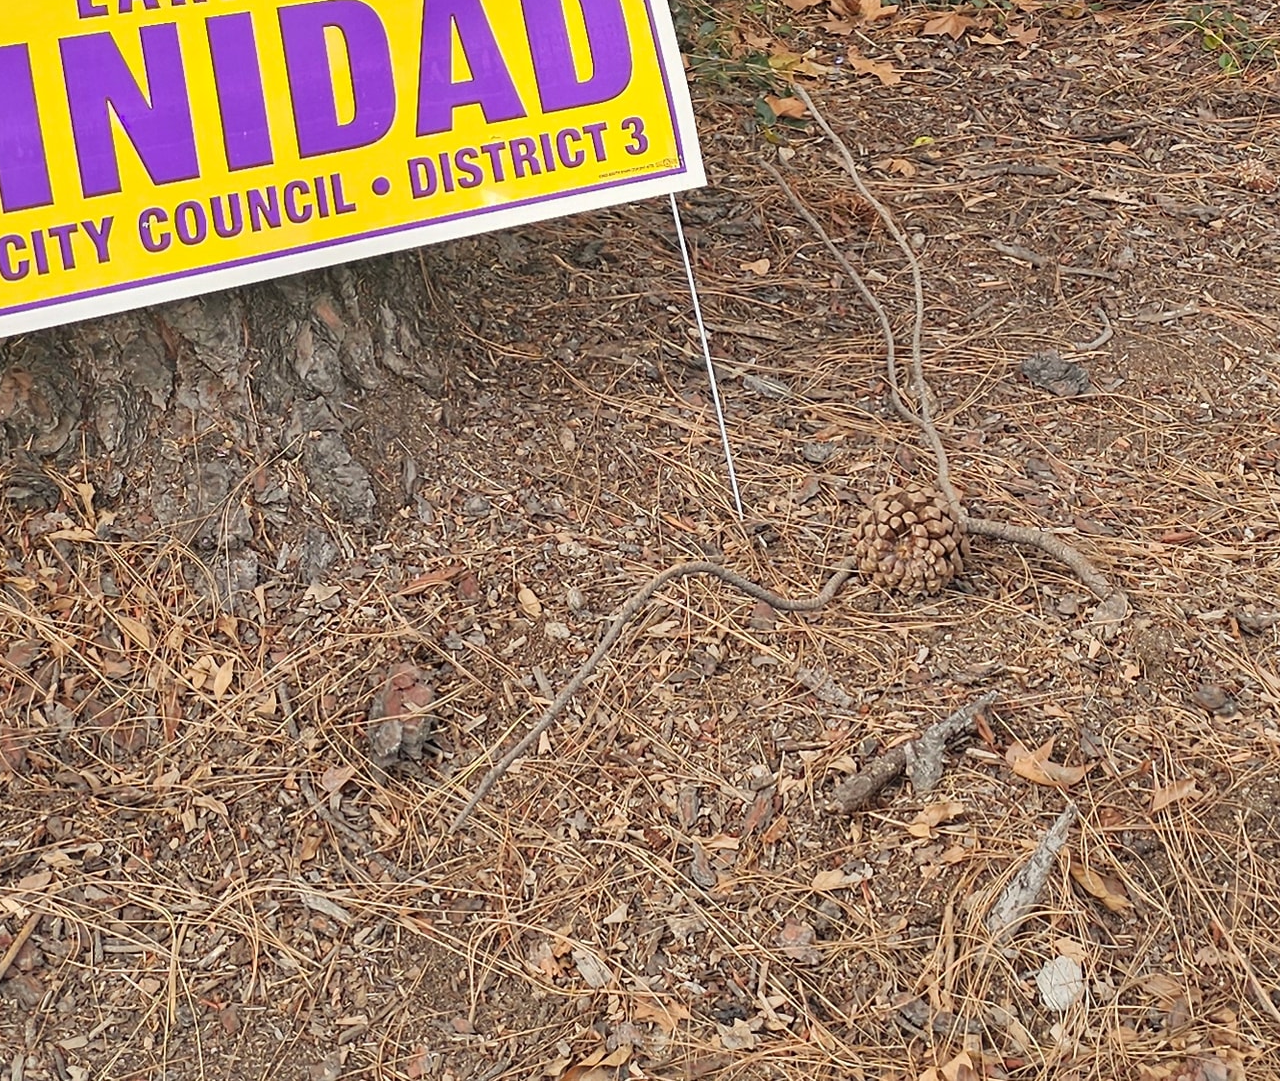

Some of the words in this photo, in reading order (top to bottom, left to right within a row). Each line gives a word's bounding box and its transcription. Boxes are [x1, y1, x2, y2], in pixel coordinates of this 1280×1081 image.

[138, 174, 357, 253] COUNCIL
[407, 122, 608, 200] DISTRICT
[622, 118, 648, 156] 3
